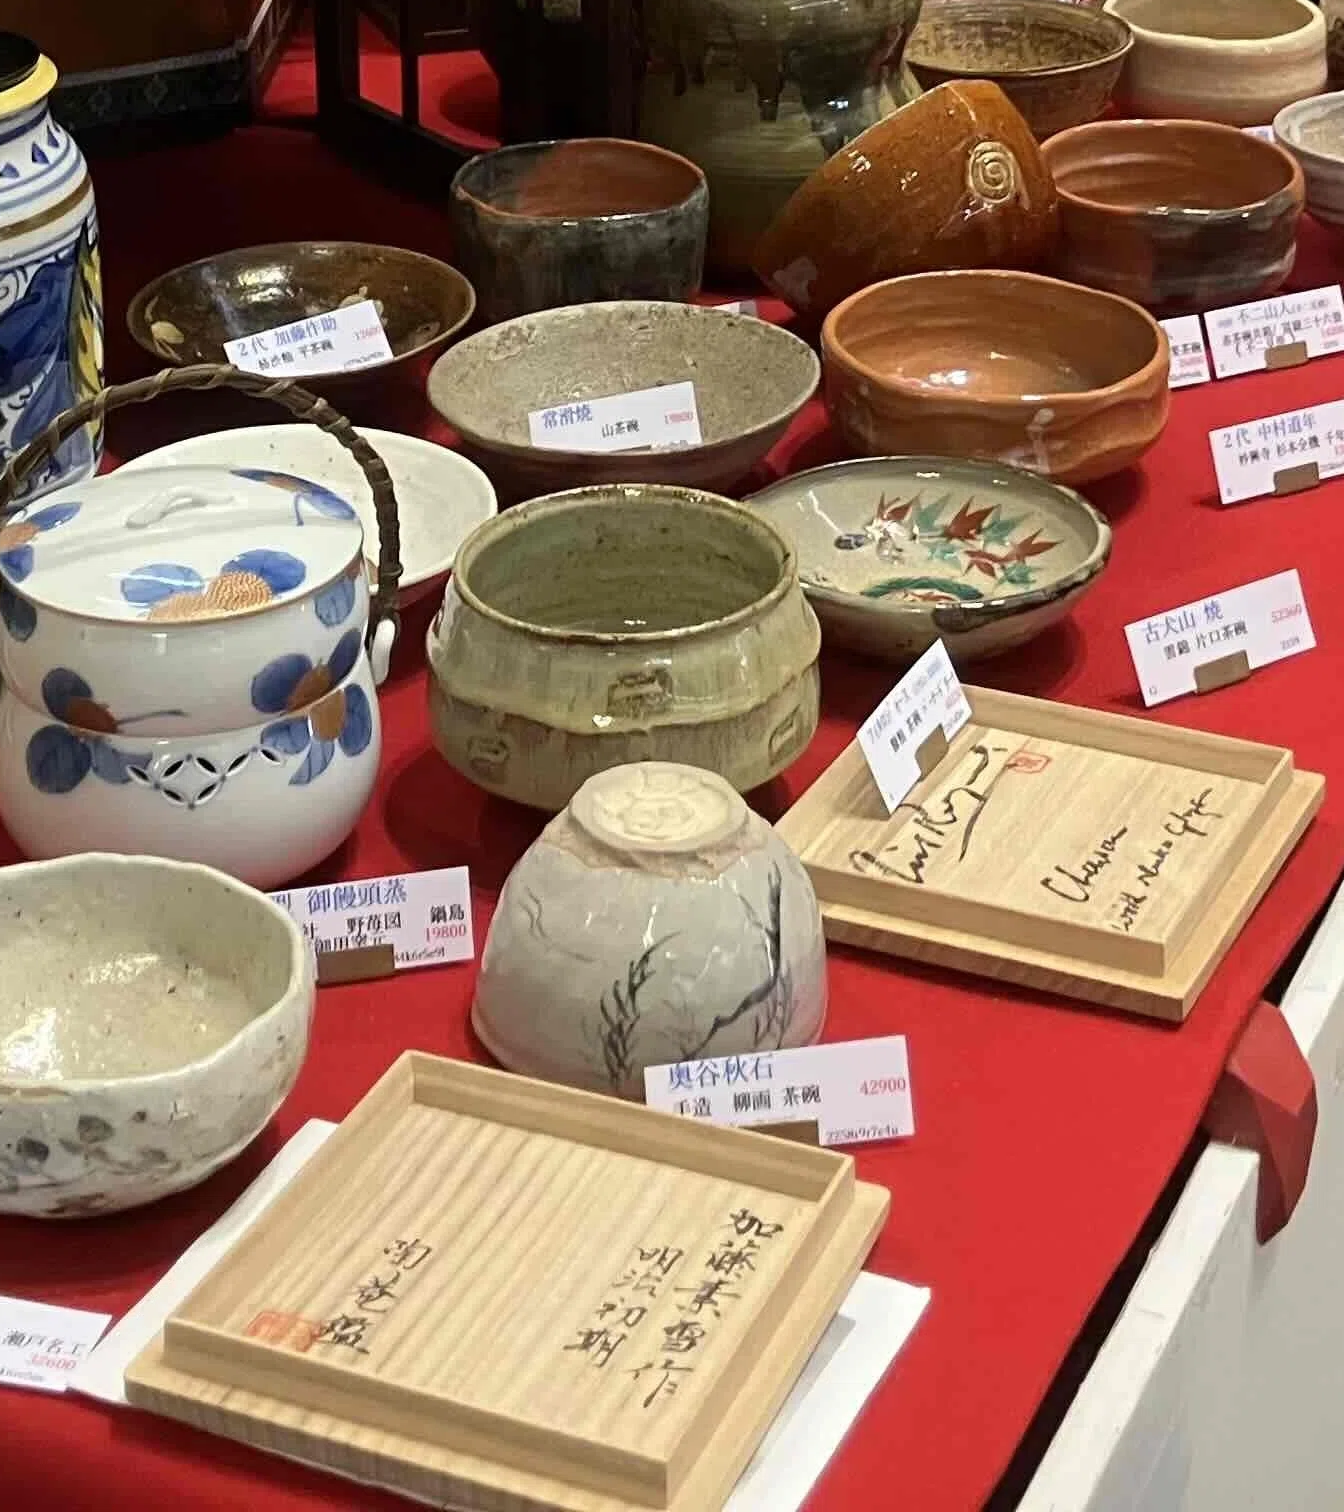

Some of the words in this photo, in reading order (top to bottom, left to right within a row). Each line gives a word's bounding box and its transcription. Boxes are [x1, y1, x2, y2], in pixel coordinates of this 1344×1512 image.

[424, 924, 467, 942] 19800
[668, 1054, 775, 1090] 奥谷秋石
[782, 1083, 822, 1107] 茶碗
[859, 1076, 907, 1096] 42900
